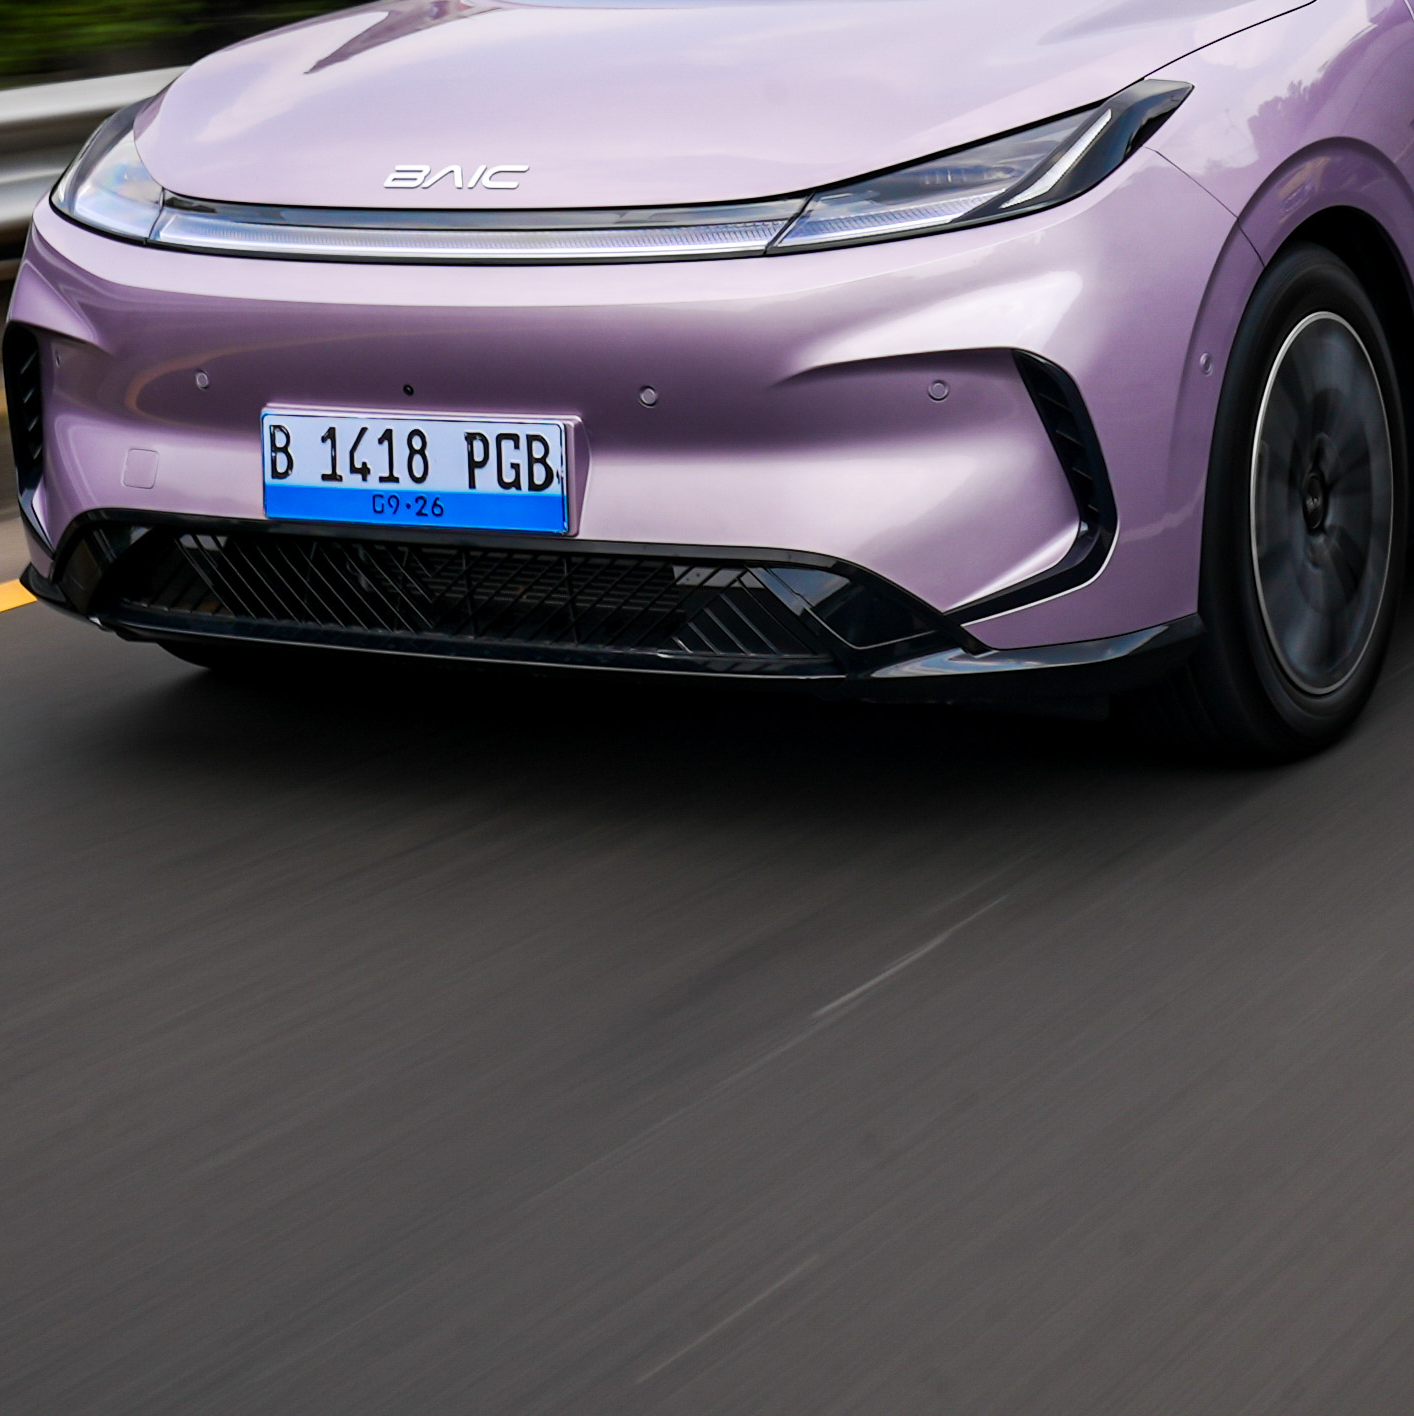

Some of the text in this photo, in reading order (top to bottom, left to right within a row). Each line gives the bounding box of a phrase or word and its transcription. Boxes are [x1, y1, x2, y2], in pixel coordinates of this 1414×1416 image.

[383, 164, 530, 190] BAIC
[269, 424, 555, 492] B 1418 PGB
